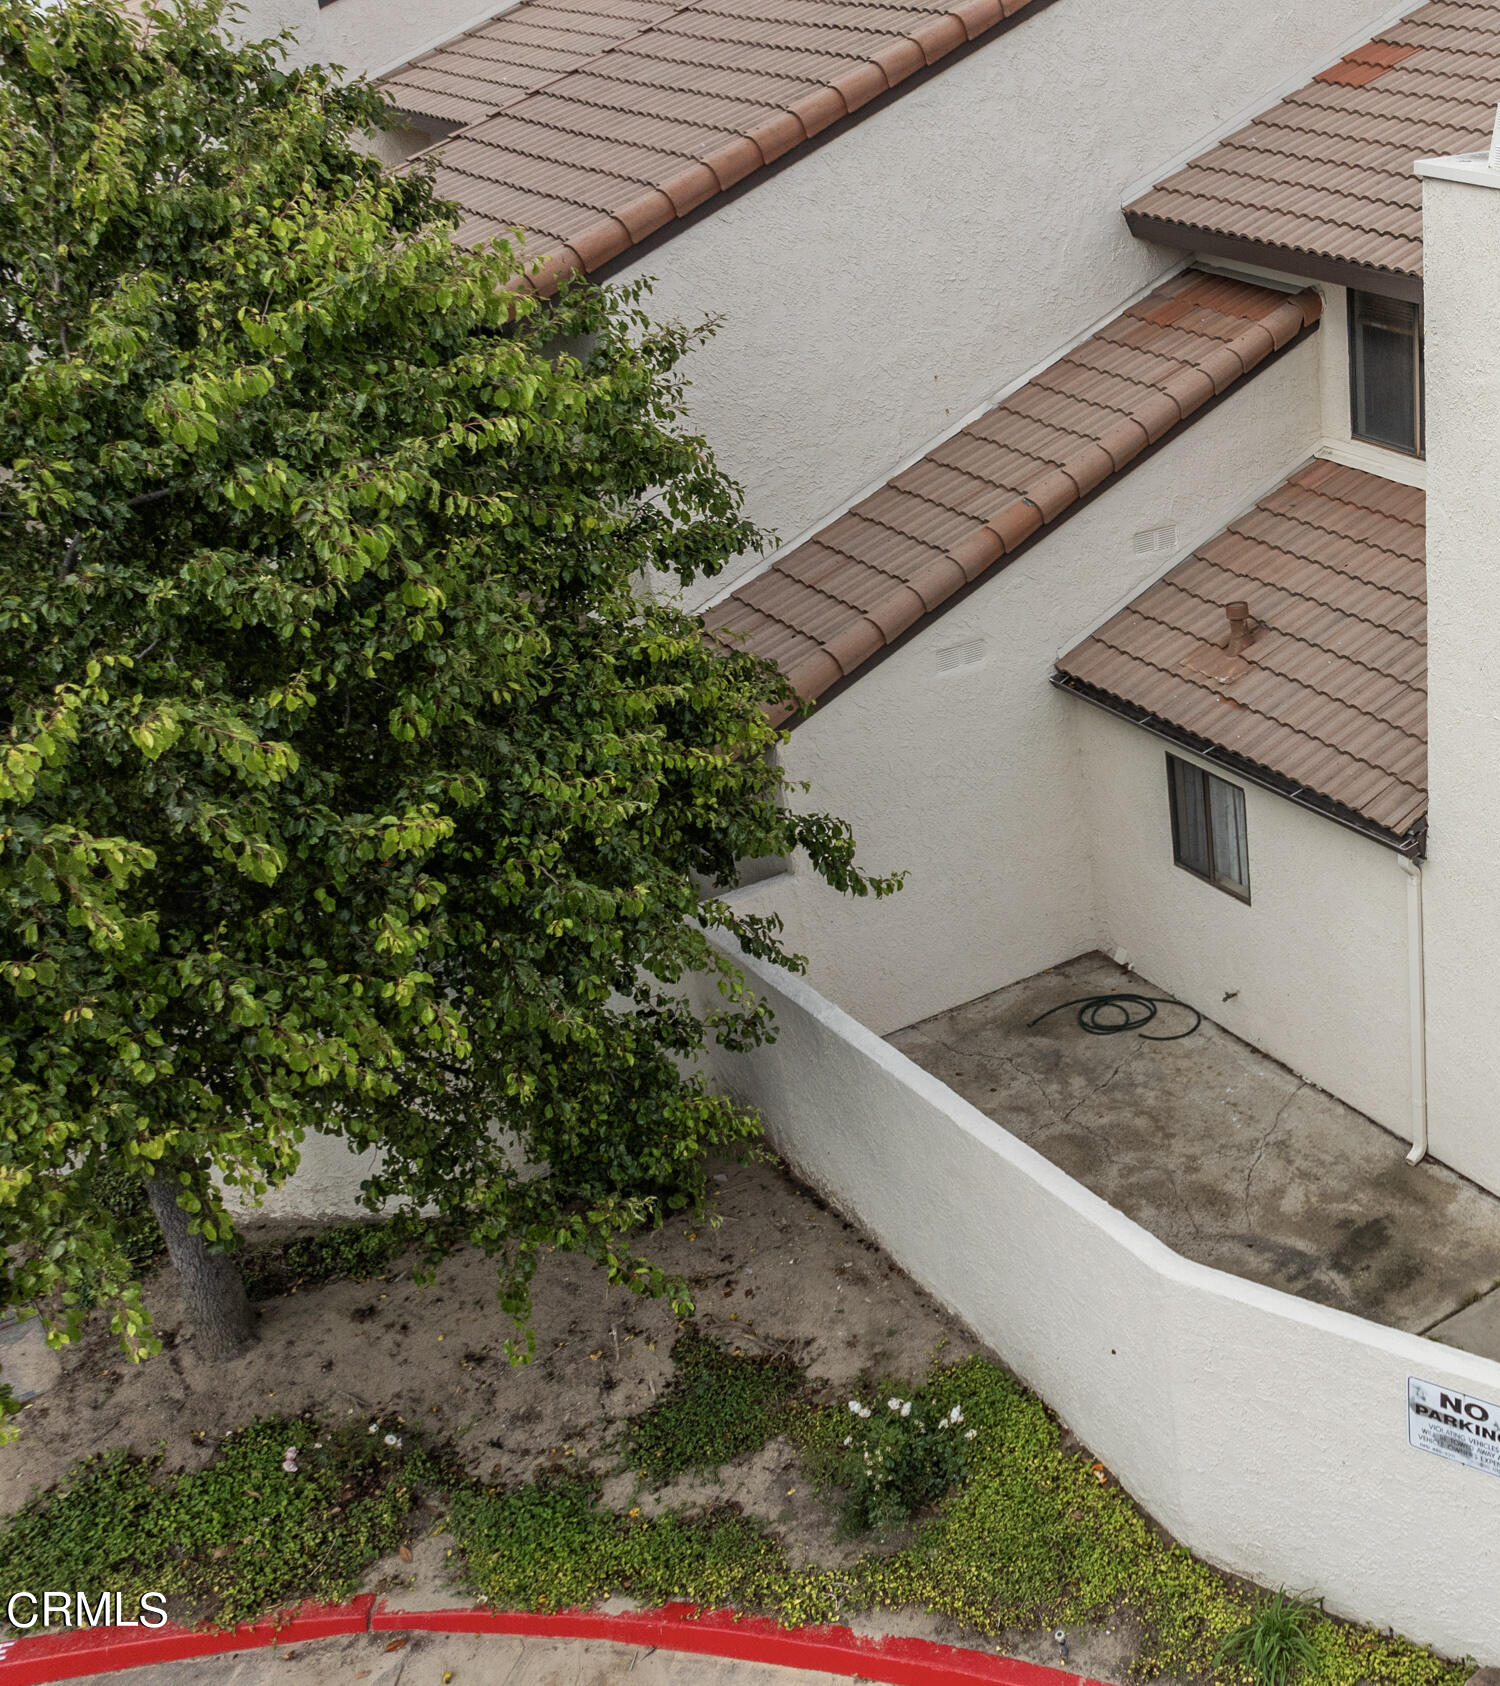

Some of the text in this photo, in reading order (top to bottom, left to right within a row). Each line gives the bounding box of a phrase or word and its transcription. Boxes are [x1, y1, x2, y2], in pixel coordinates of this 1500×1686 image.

[1440, 1392, 1489, 1422] NO
[1428, 1422, 1465, 1441] VIOLATING
[1468, 1437, 1499, 1453] VEHICLES
